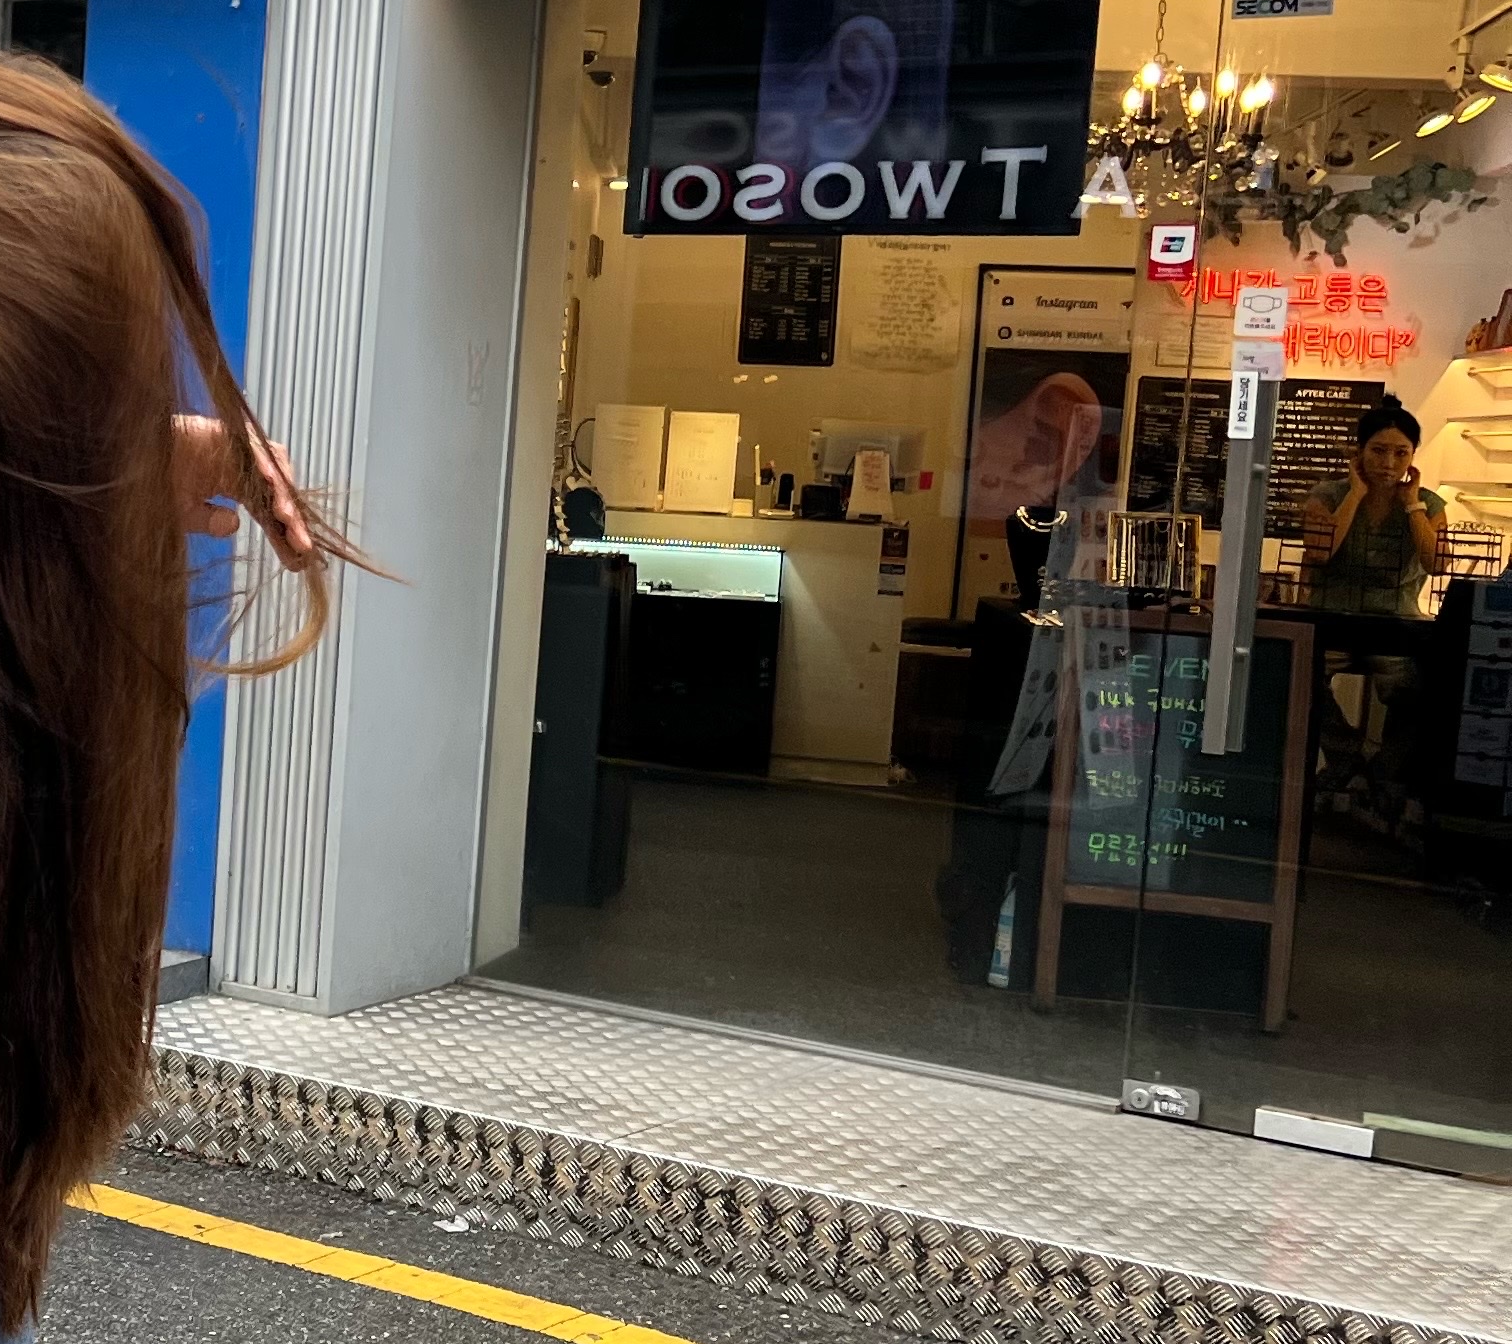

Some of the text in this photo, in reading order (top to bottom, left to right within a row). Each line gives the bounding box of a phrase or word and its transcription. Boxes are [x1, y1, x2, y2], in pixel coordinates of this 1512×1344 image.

[1035, 295, 1098, 312] Instagram
[1287, 273, 1387, 313] 고통은
[1236, 377, 1251, 423] 당기세요
[1295, 388, 1352, 399] AFTER CARE
